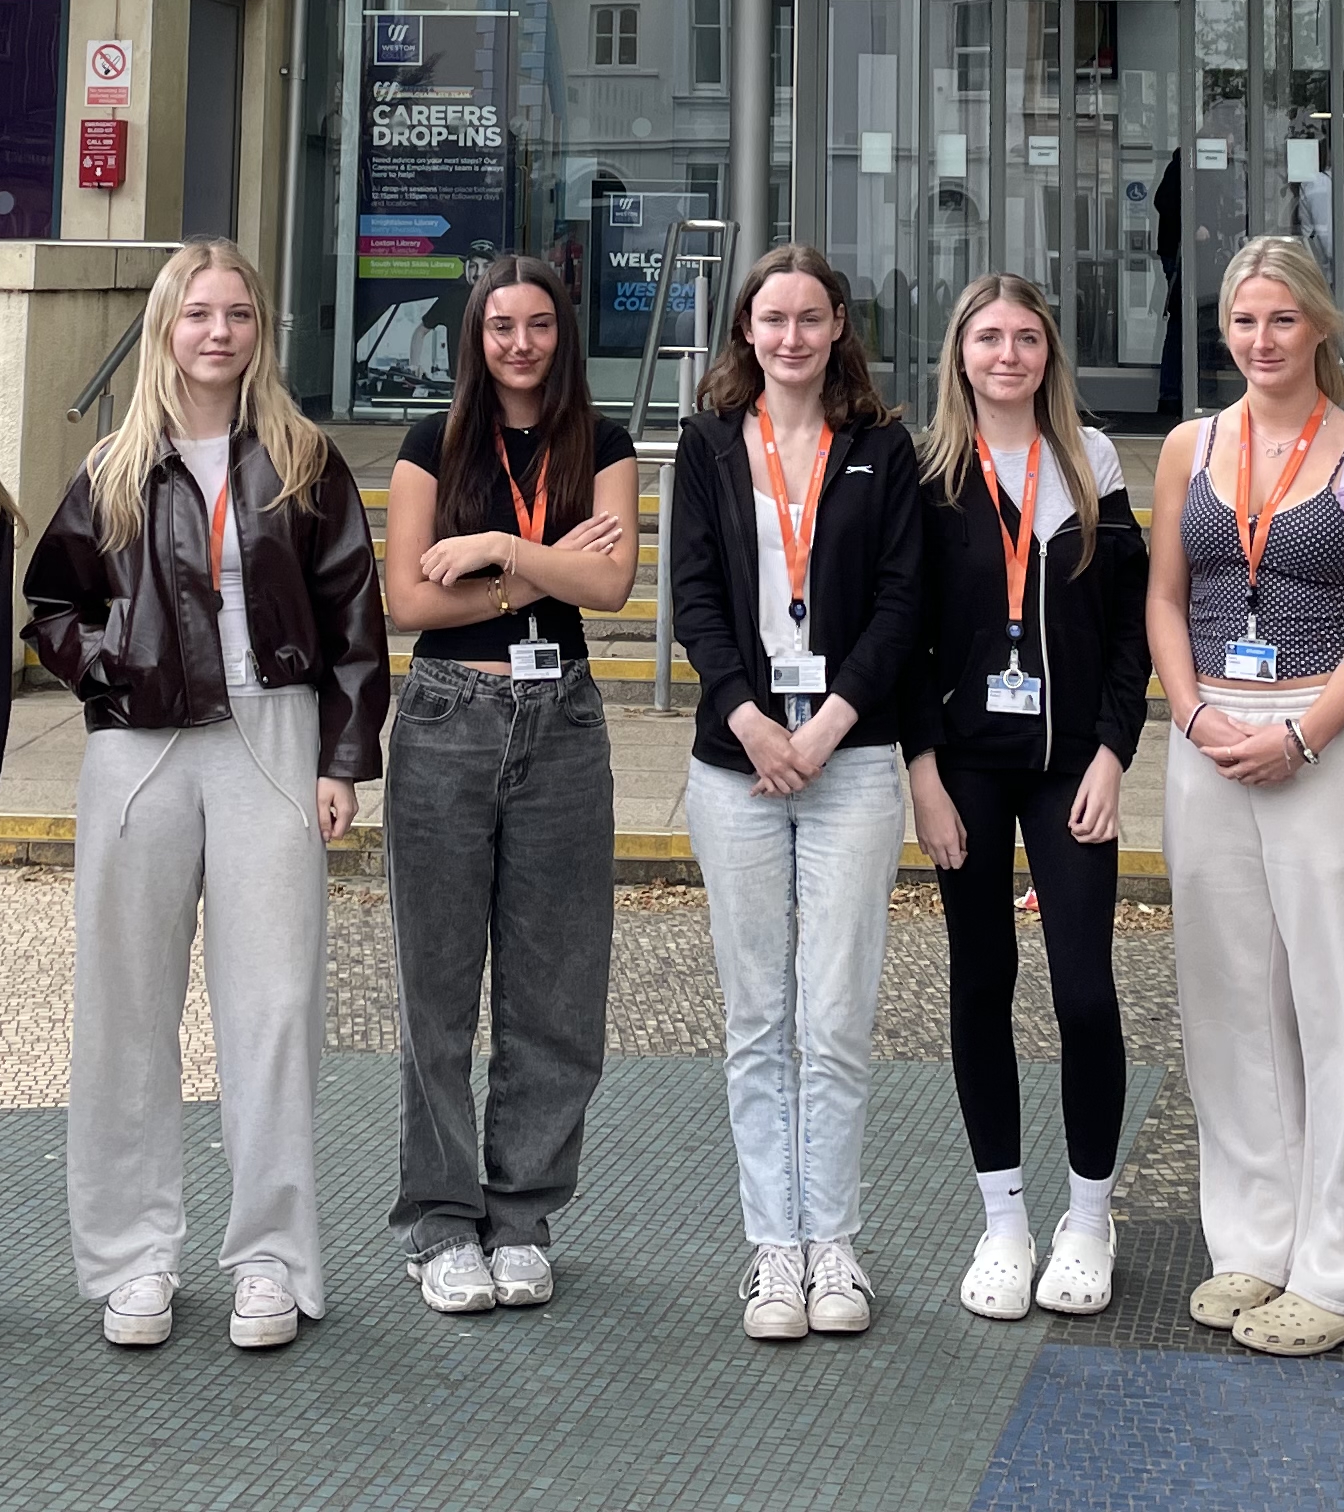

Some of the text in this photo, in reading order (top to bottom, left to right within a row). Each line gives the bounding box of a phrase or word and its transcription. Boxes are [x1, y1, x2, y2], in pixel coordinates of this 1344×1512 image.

[381, 44, 416, 52] WESTON
[372, 104, 498, 126] CAREERS
[372, 125, 502, 147] DROP-INS
[372, 164, 398, 172] Careers
[406, 164, 453, 172] Employability
[454, 164, 472, 172] team
[480, 164, 504, 172] always
[414, 219, 439, 227] Library
[370, 239, 421, 247] Loxton Library
[370, 260, 391, 268] South
[392, 260, 410, 268] West
[430, 260, 455, 268] Library
[609, 252, 700, 268] WELCME
[616, 282, 695, 297] WESON
